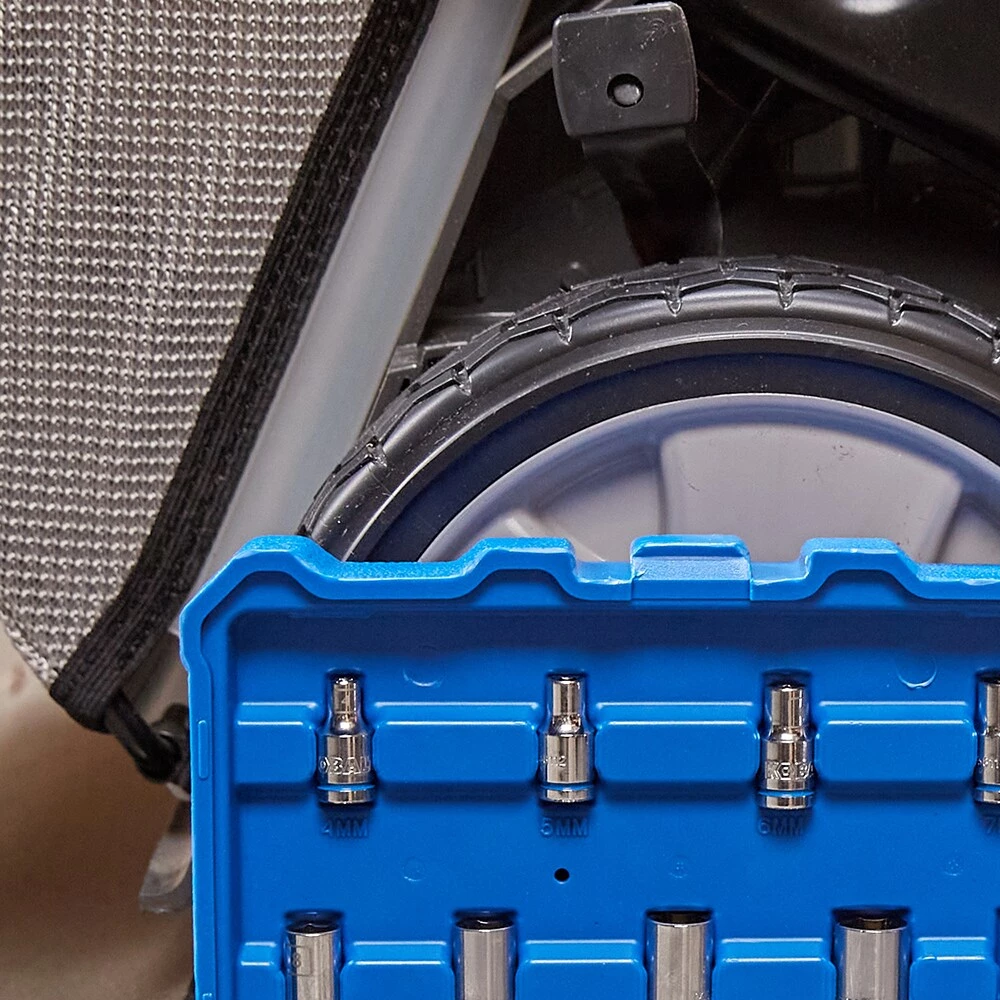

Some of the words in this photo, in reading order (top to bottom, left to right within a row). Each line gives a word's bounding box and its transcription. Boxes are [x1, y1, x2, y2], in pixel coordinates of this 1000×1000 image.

[321, 817, 369, 837] 4MM
[540, 817, 588, 836] 5MM
[758, 816, 804, 836] 6MM
